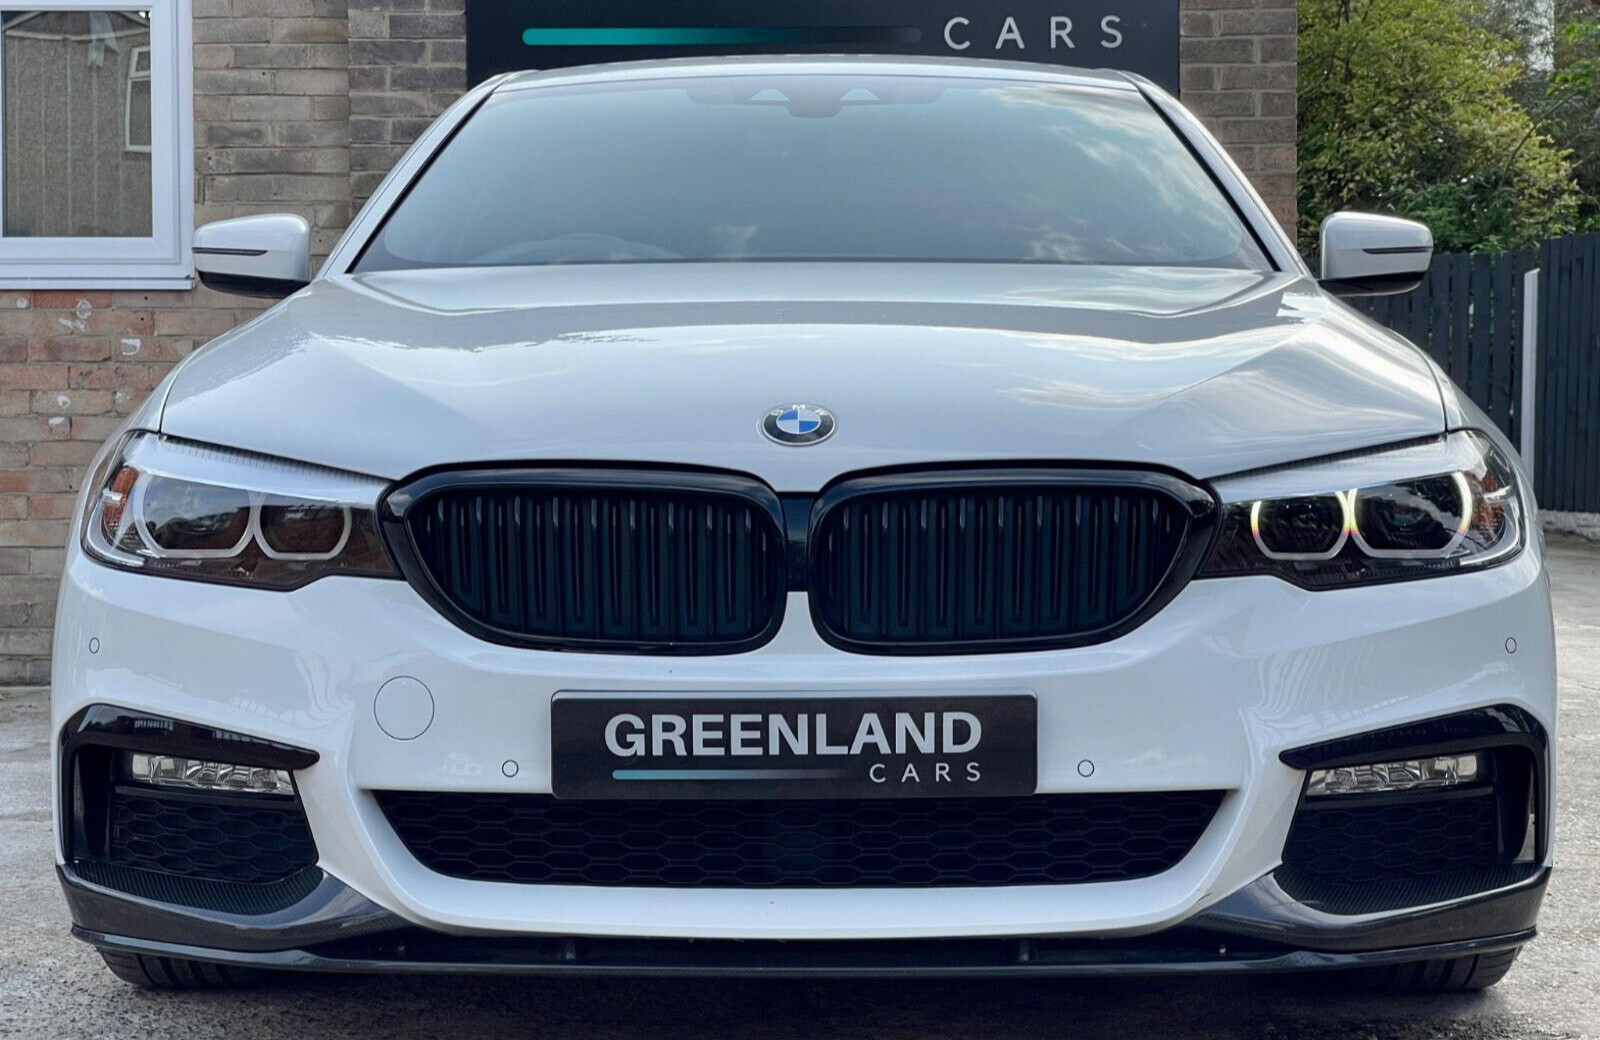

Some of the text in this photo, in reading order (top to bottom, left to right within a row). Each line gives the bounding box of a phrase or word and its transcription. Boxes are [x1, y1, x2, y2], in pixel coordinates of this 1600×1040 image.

[943, 15, 1124, 50] CARS
[604, 711, 982, 757] GREENLAND
[868, 762, 982, 784] CARS
